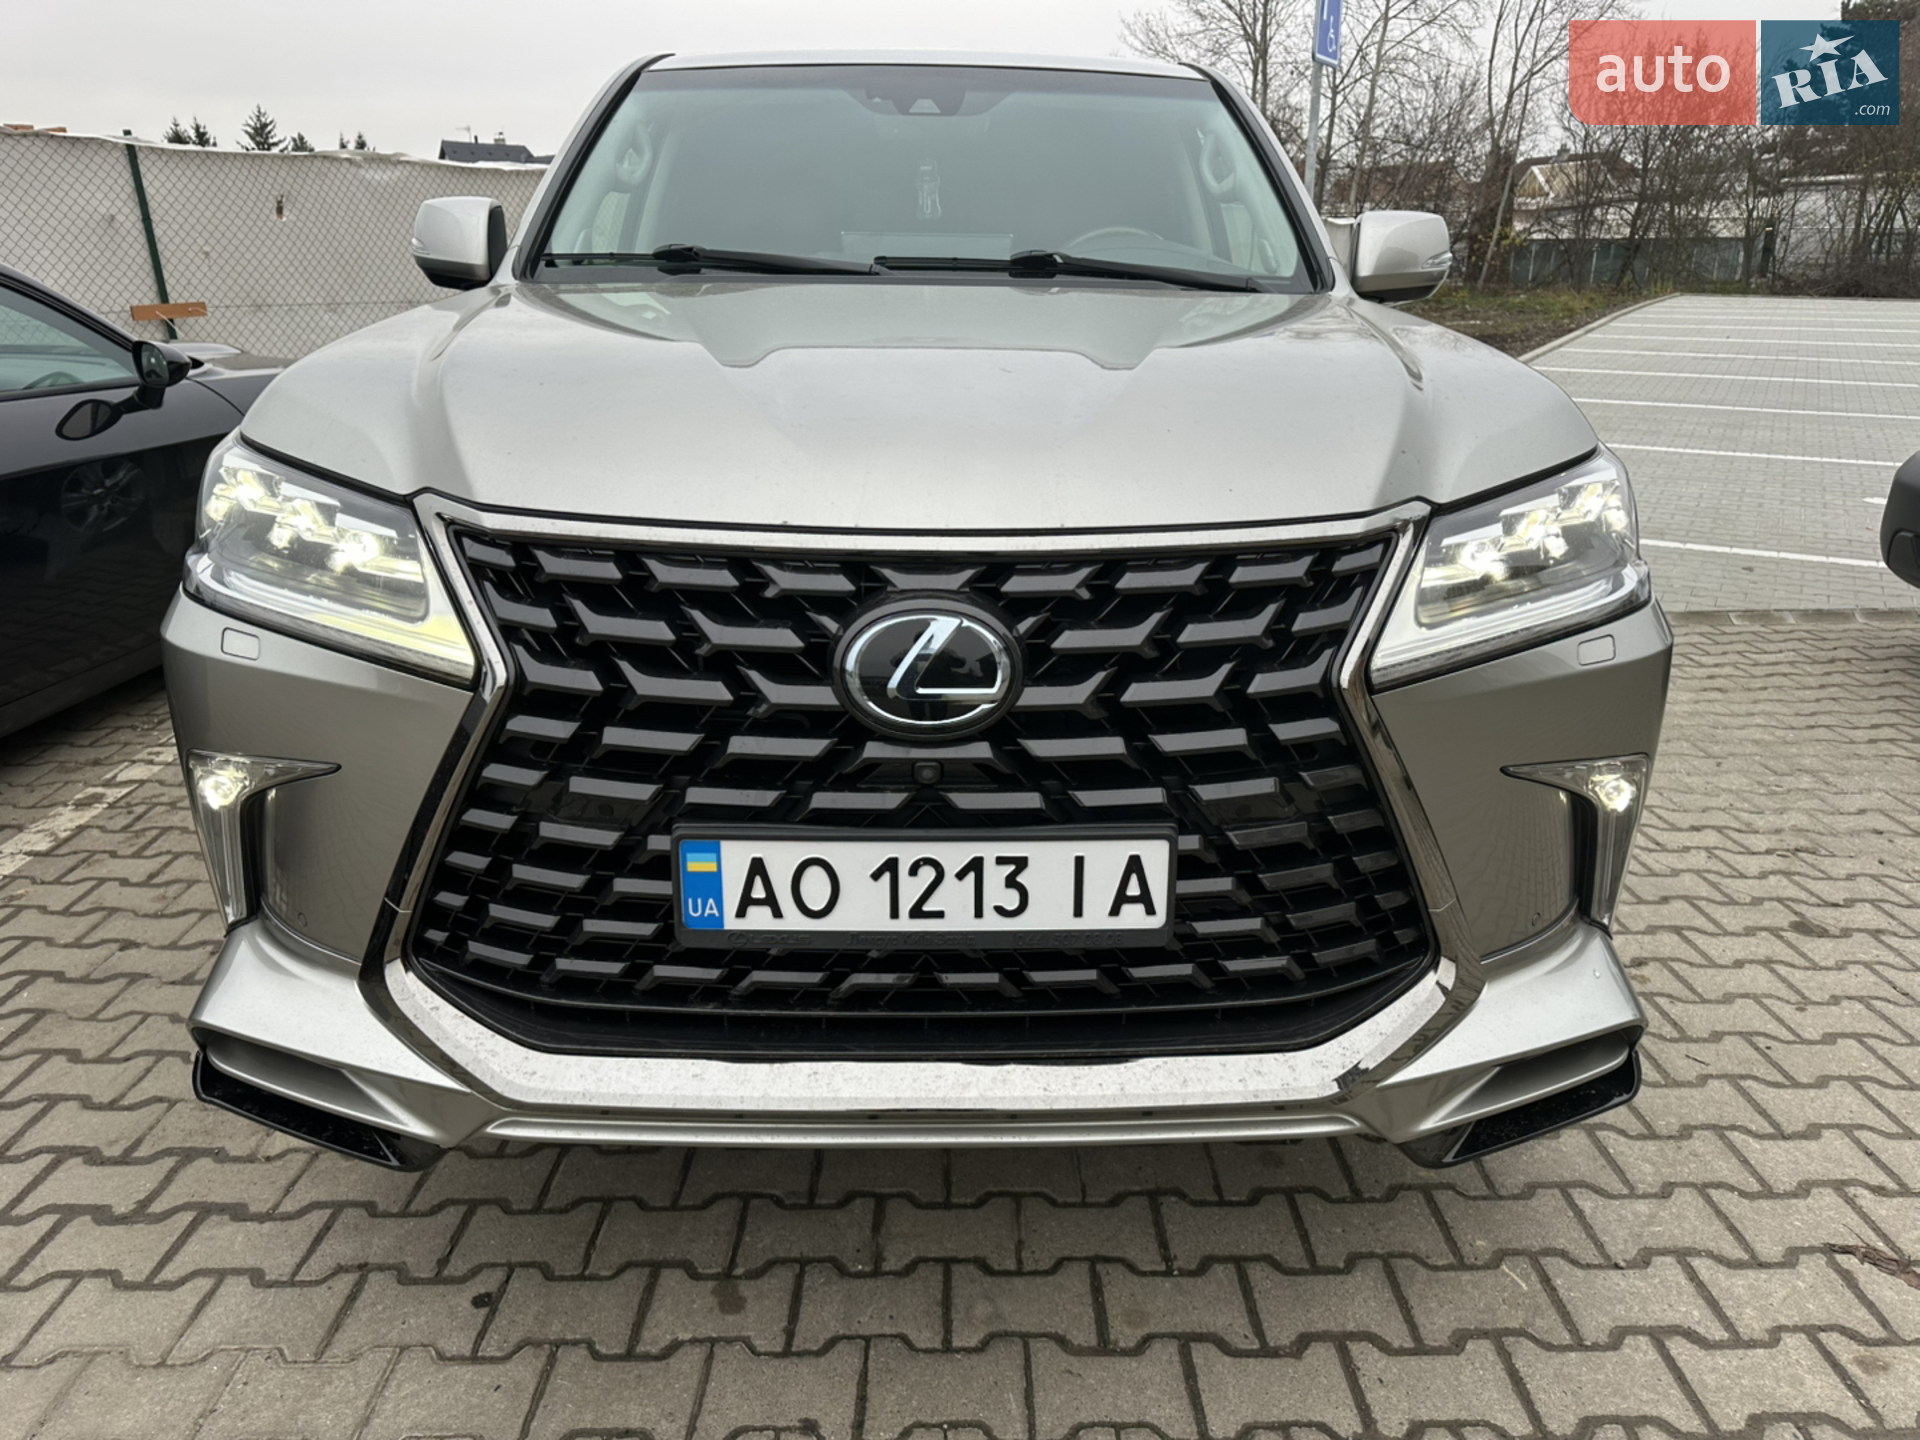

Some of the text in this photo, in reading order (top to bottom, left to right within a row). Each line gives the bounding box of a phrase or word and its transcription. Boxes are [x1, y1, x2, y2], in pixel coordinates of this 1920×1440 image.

[734, 854, 1157, 920] AO 1213 IA
[687, 897, 720, 918] UA
[749, 933, 812, 945] LEXUS
[1051, 931, 1080, 946] 507
